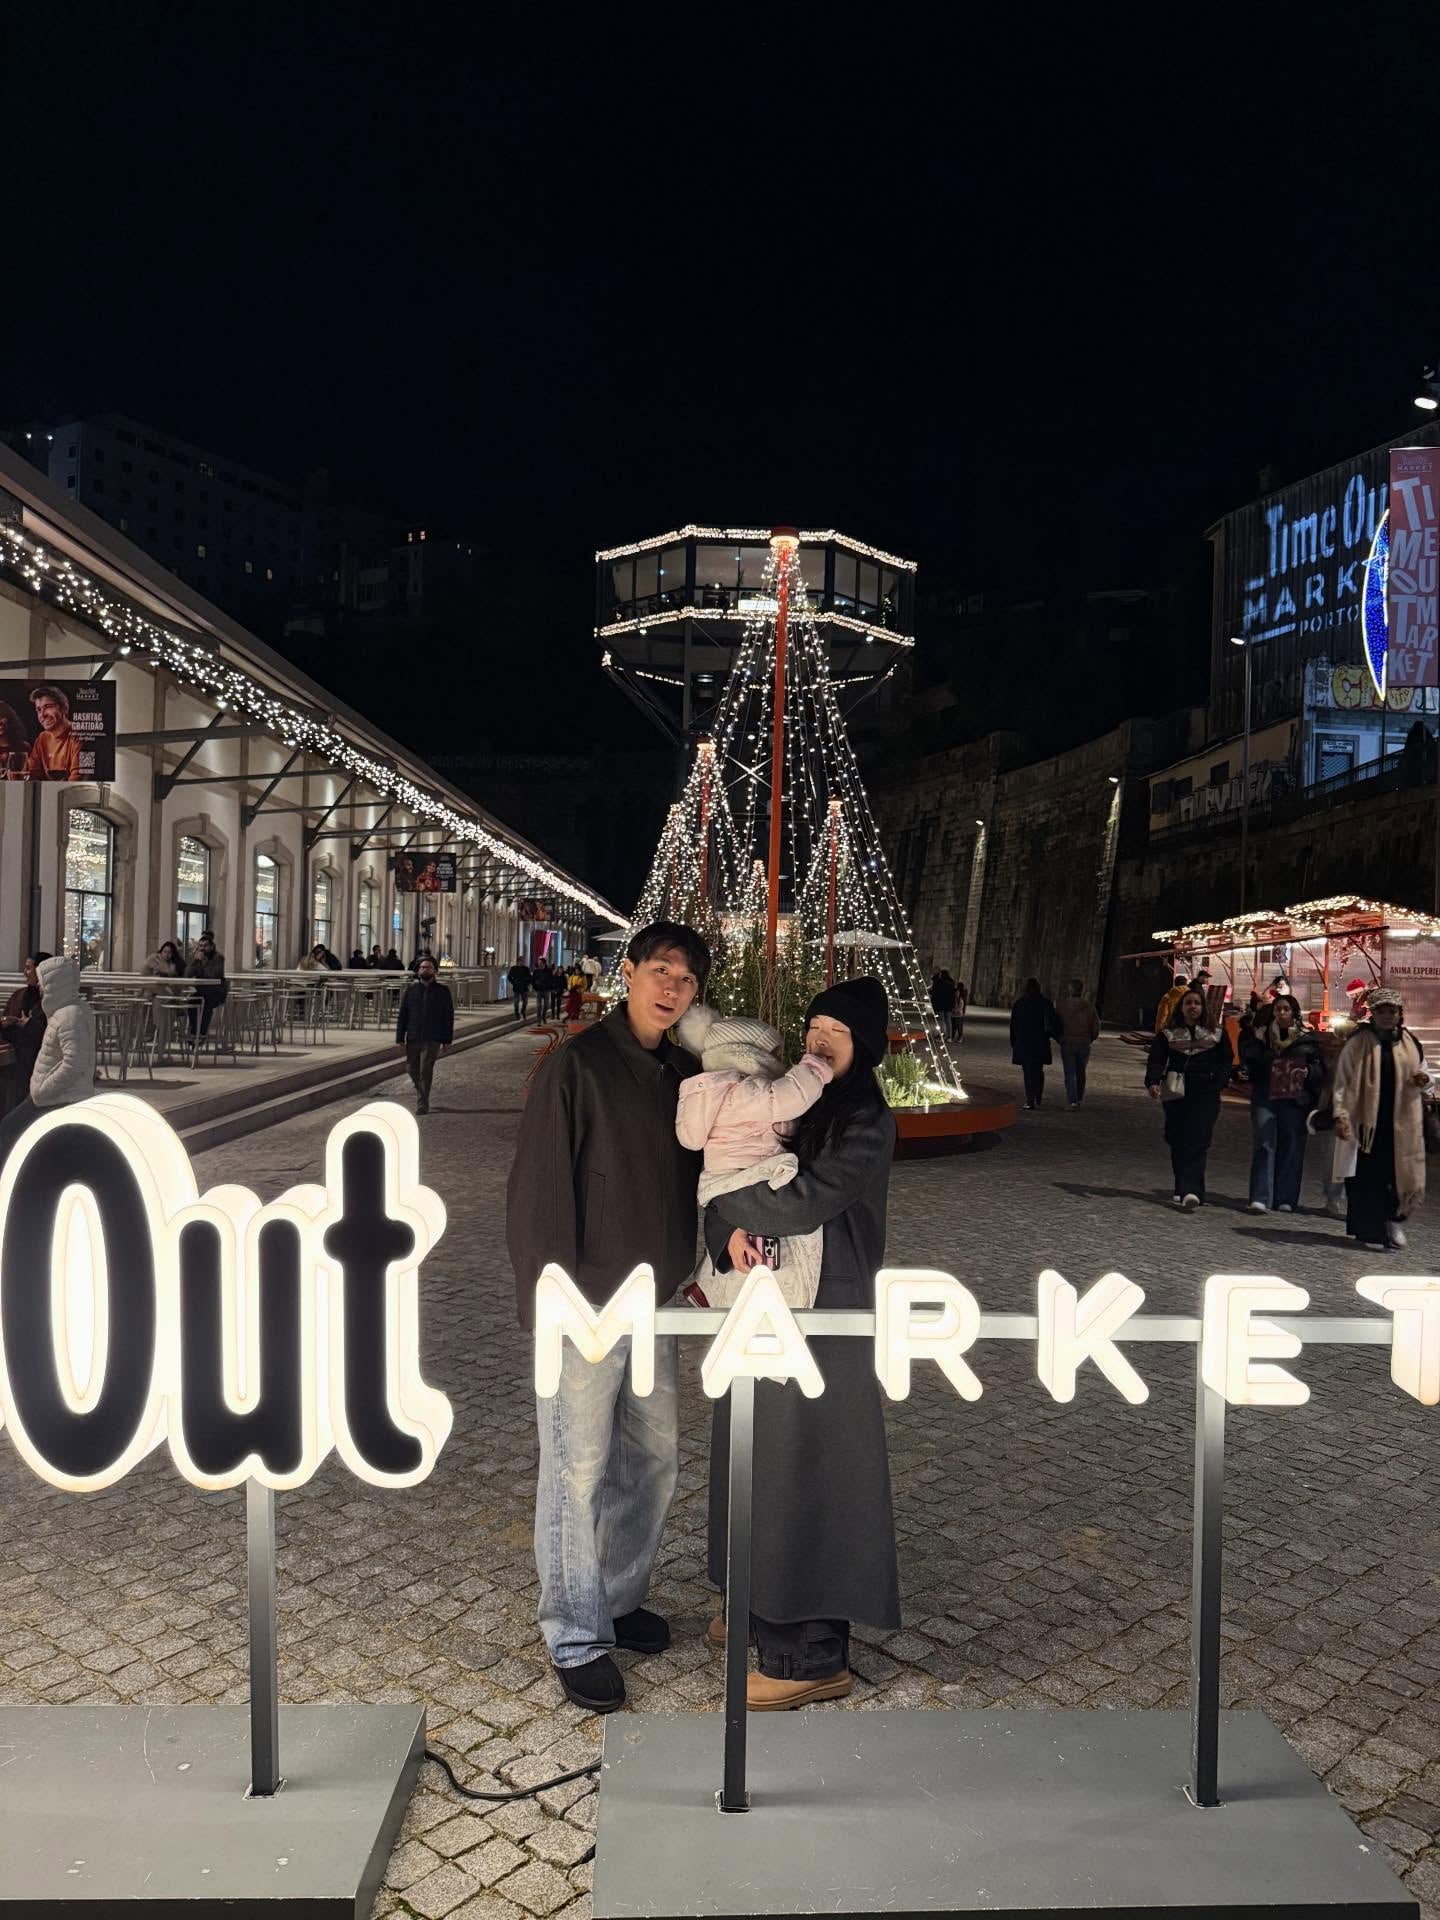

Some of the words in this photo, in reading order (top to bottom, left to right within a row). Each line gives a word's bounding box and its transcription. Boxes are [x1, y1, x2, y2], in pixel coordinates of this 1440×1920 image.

[1265, 503, 1337, 578] Time
[1299, 604, 1359, 637] PORTO
[73, 712, 103, 722] HASHTAG
[1390, 966, 1411, 975] ANIMA
[0, 1110, 440, 1486] Out
[534, 1263, 1440, 1406] MARKET
